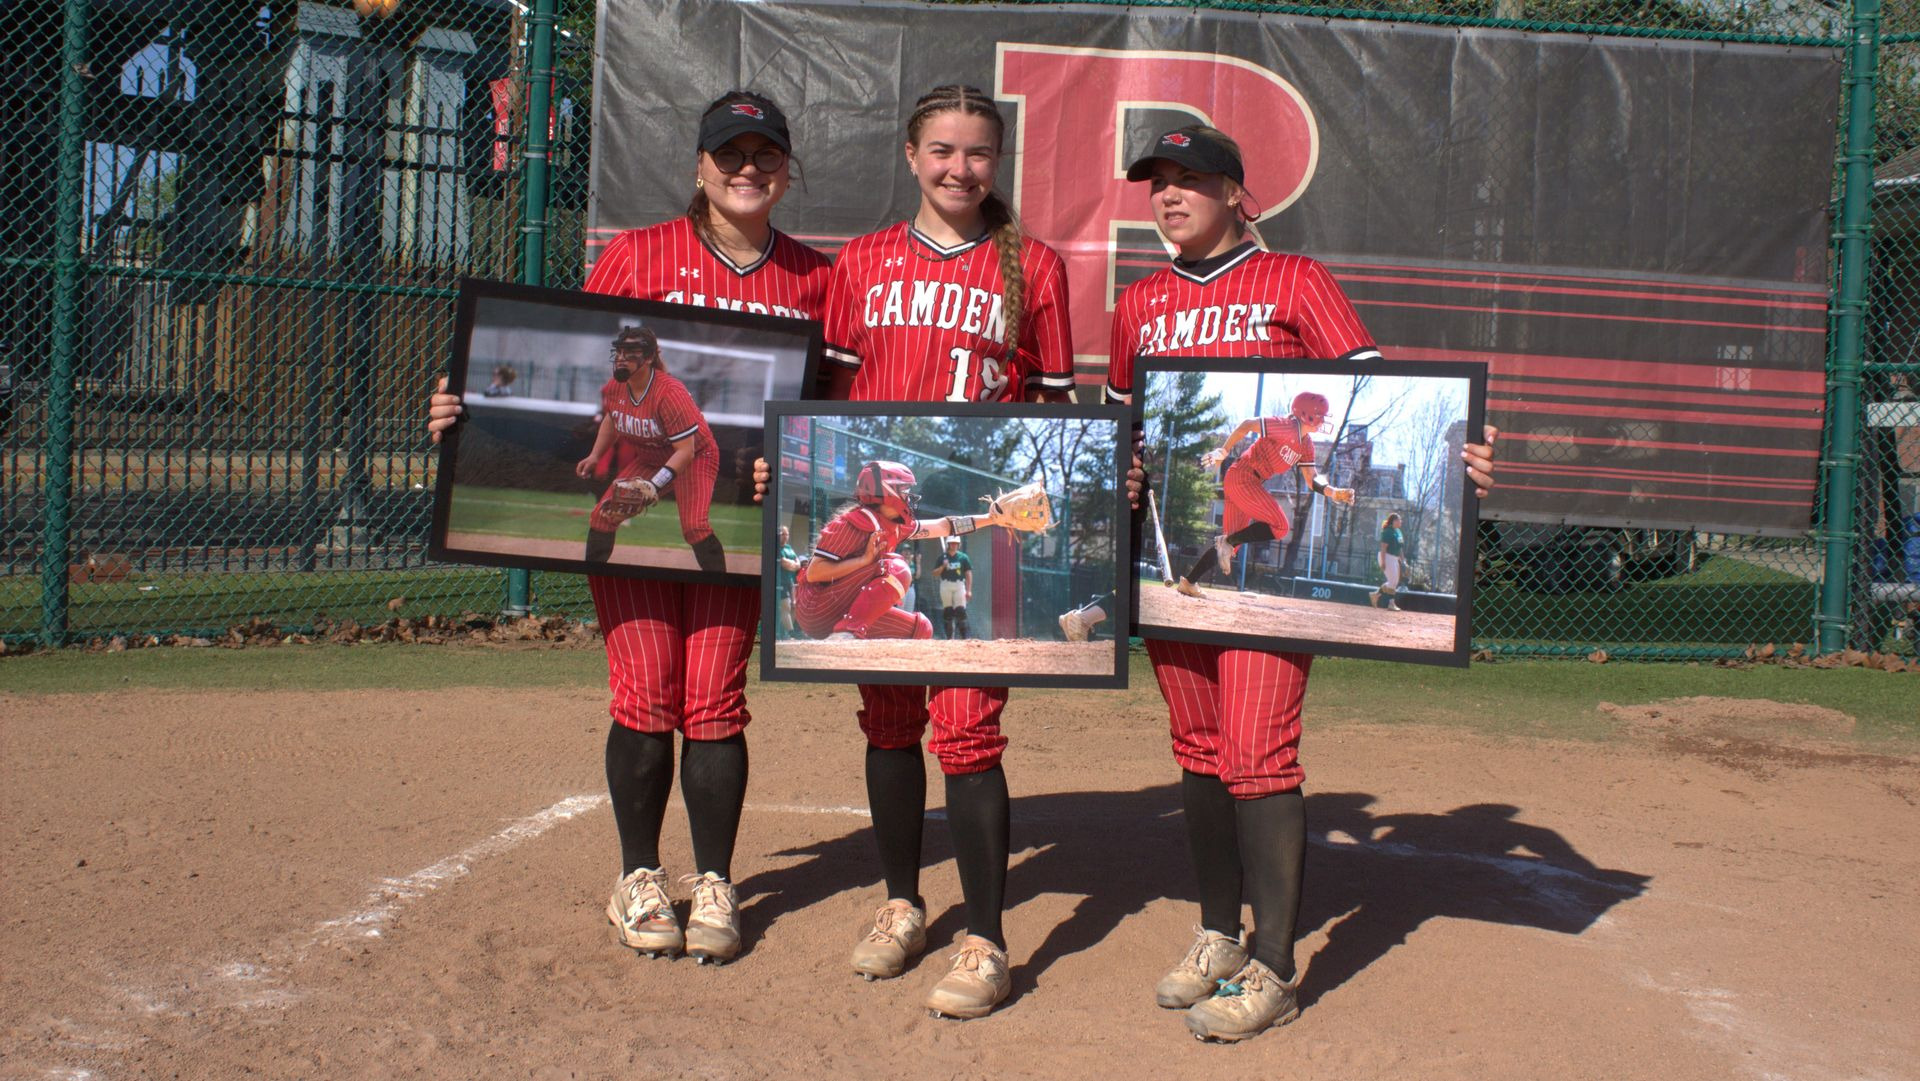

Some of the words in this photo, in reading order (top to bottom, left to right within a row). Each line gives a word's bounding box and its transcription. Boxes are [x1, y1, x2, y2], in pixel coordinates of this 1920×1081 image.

[993, 42, 1319, 363] R
[864, 280, 1007, 344] CAMDEN
[1137, 303, 1276, 356] CAMDEN
[1311, 586, 1332, 599] 200
